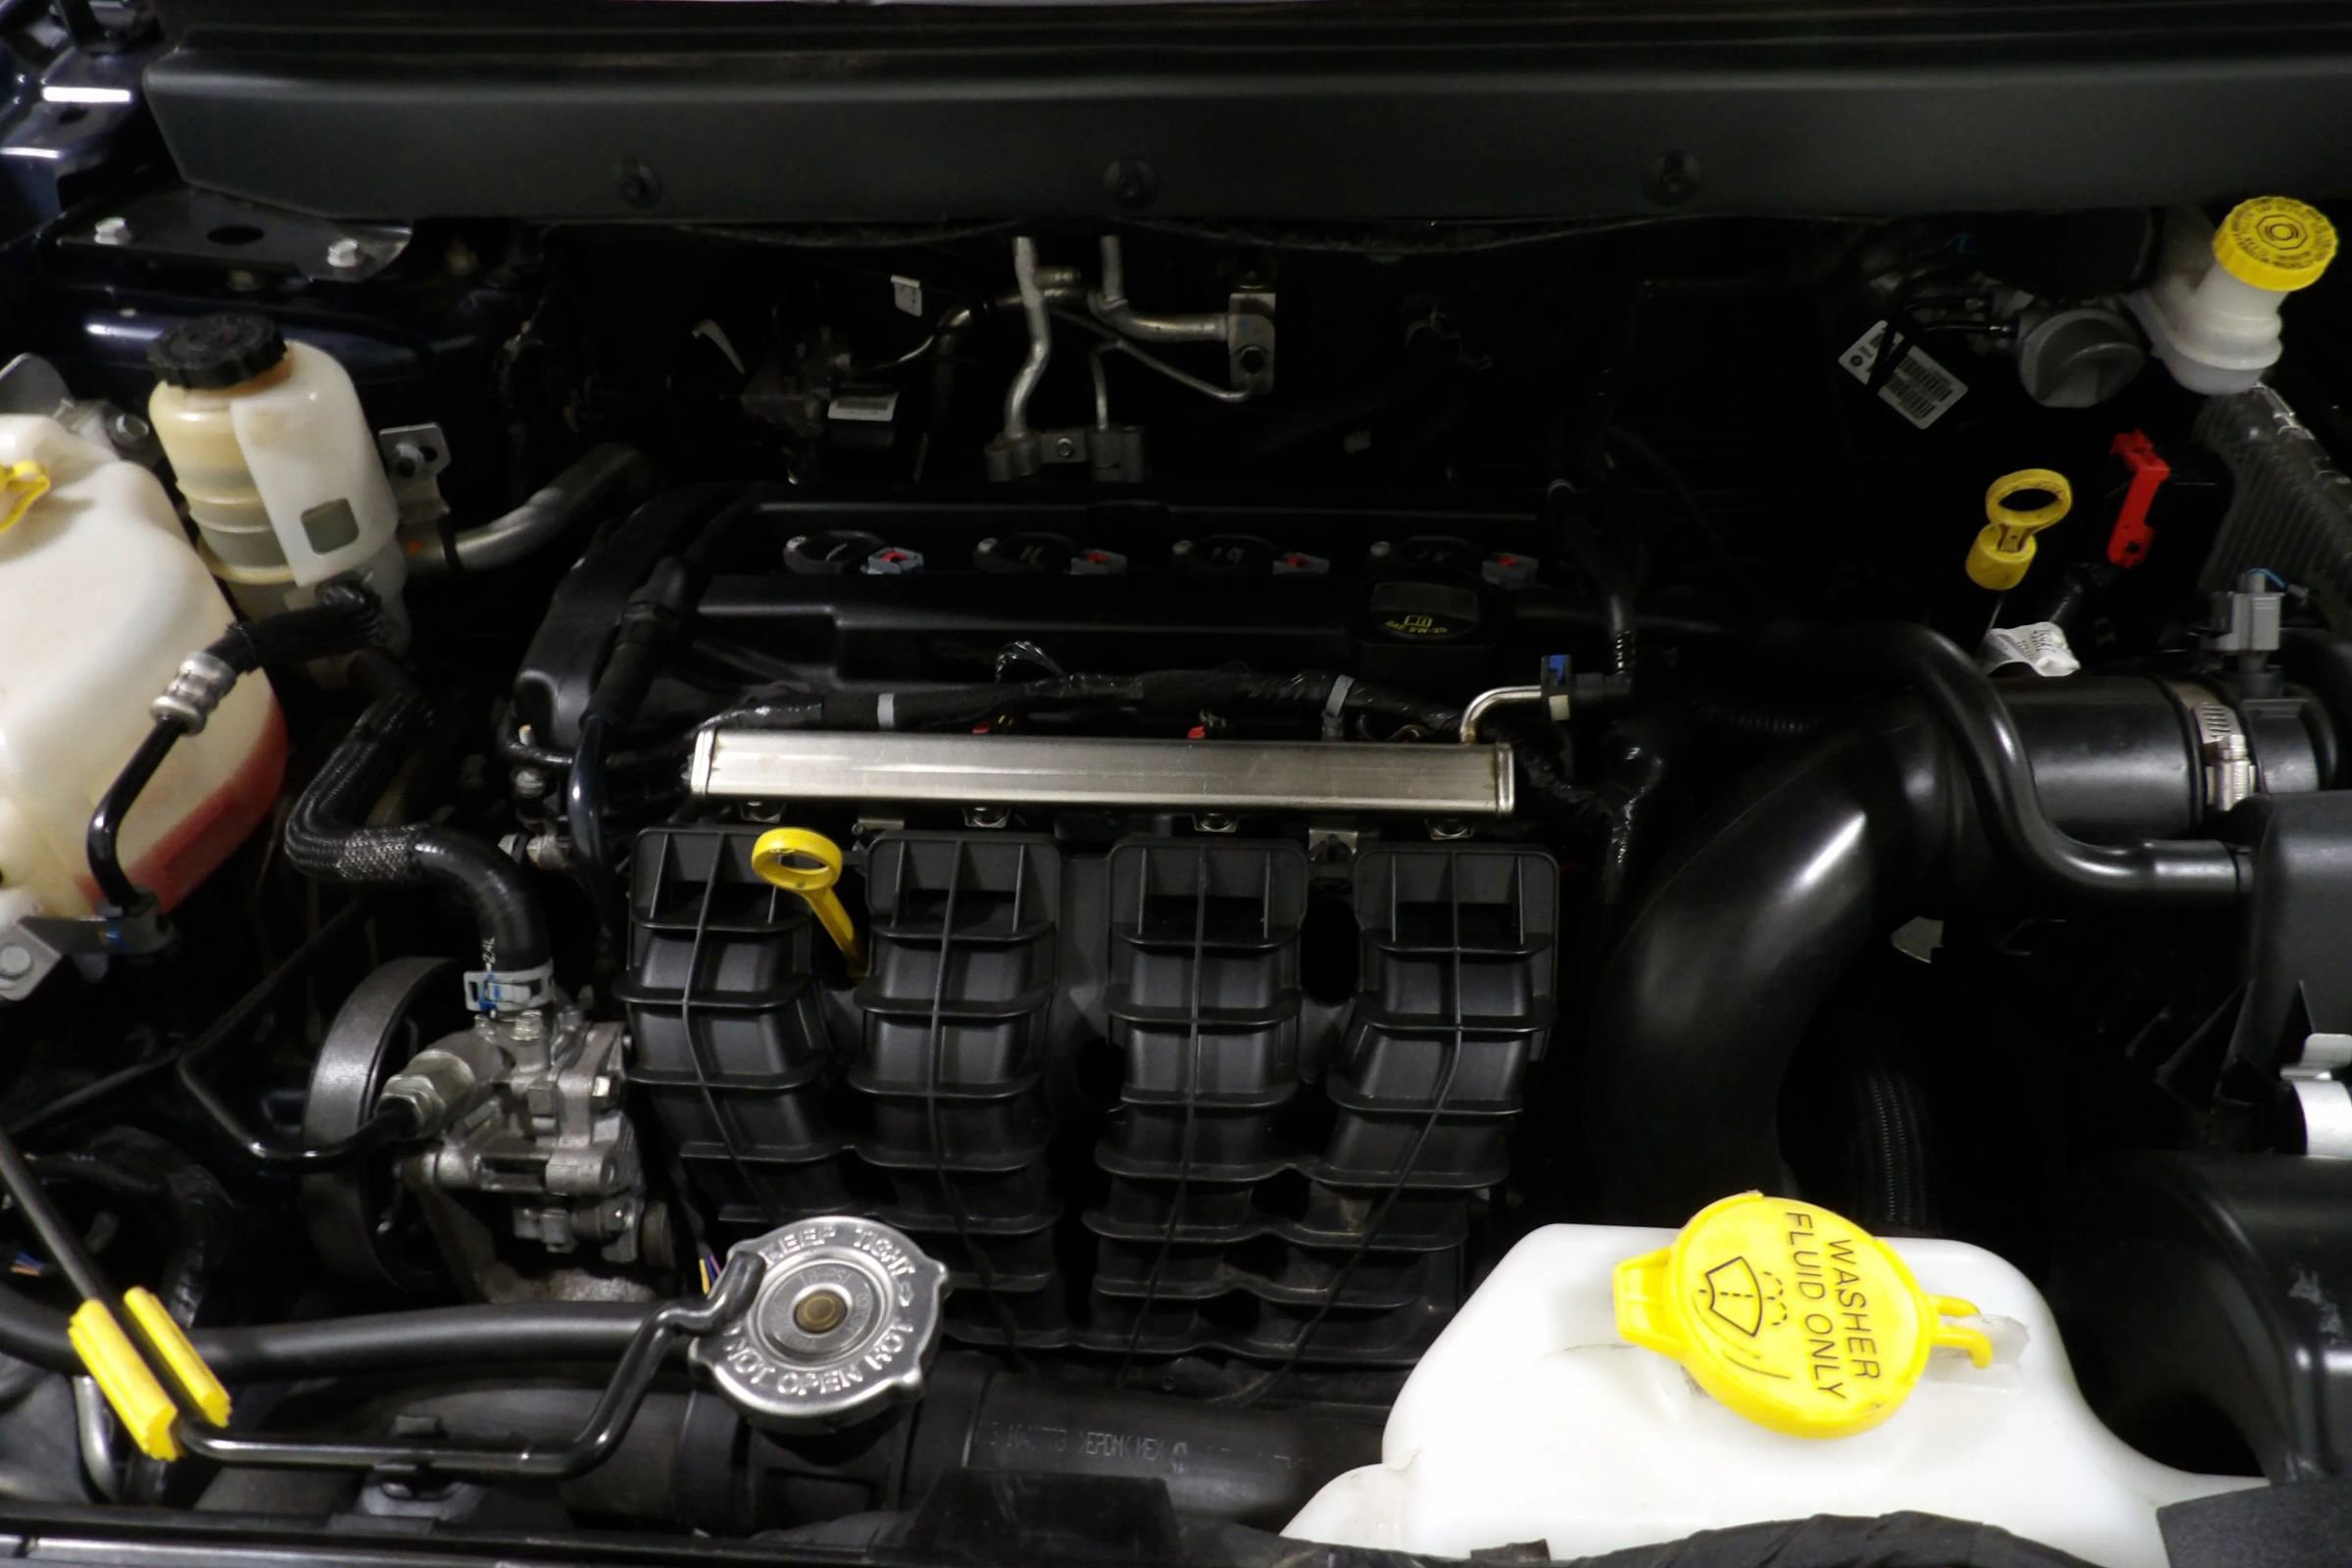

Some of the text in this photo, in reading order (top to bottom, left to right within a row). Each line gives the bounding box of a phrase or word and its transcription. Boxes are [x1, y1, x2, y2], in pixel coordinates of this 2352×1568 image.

[758, 1226, 915, 1276] KEEP TIGHT
[1786, 1211, 1847, 1400] FLUID ONLY
[777, 1364, 863, 1396] OPEN
[864, 1318, 914, 1371] HOT
[1828, 1238, 1881, 1381] WASHER
